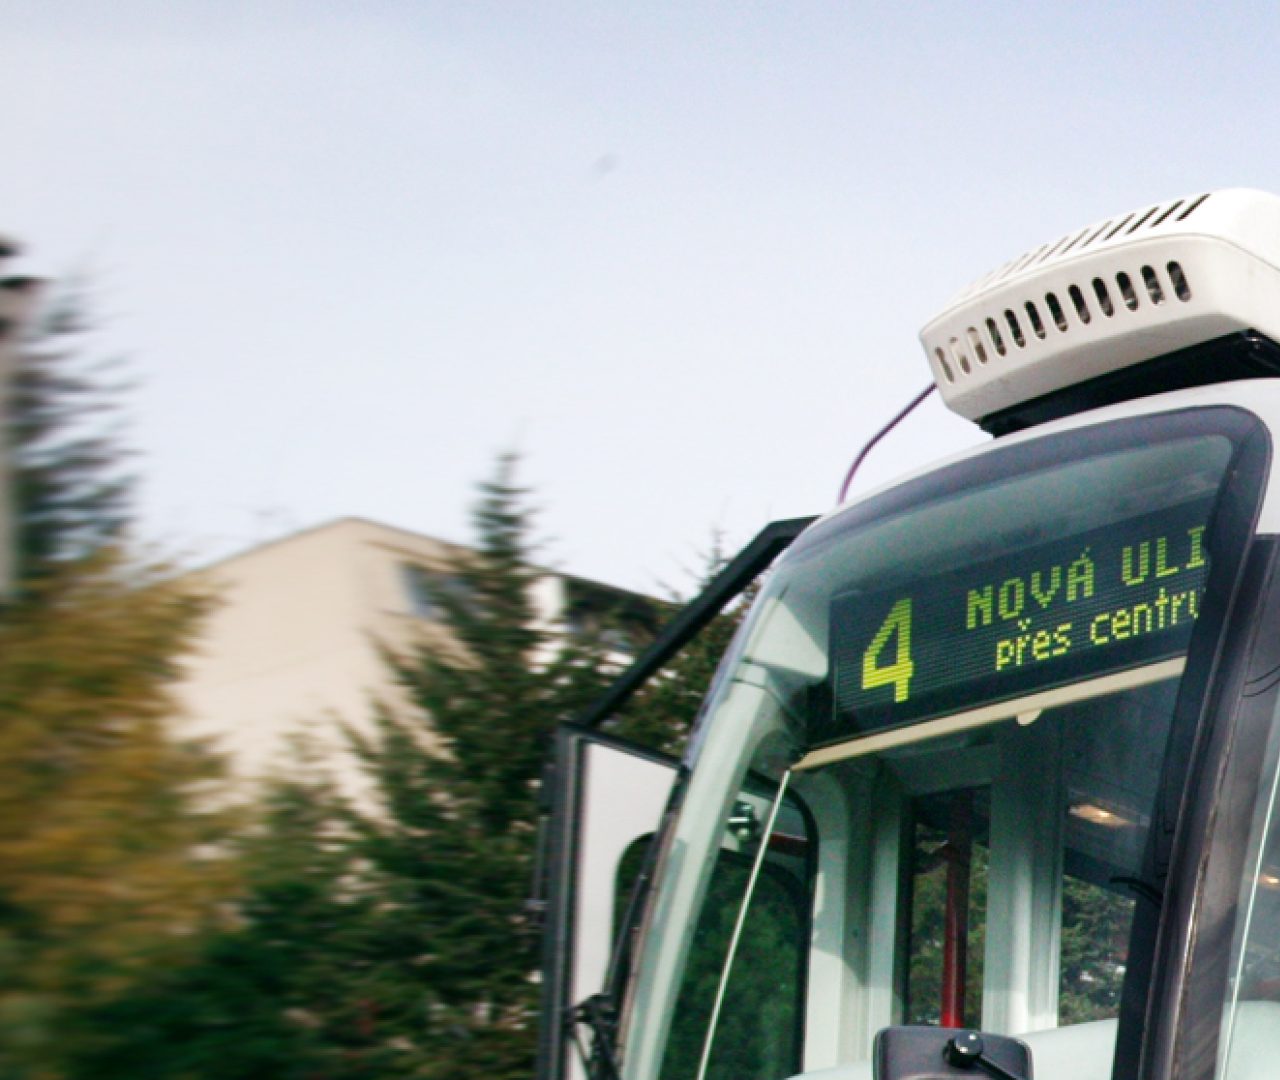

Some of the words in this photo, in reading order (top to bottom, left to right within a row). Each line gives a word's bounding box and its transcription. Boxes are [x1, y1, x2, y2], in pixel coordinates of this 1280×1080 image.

[966, 546, 1095, 630] NOVÁ
[861, 598, 914, 703] 4
[995, 616, 1072, 671] přes
